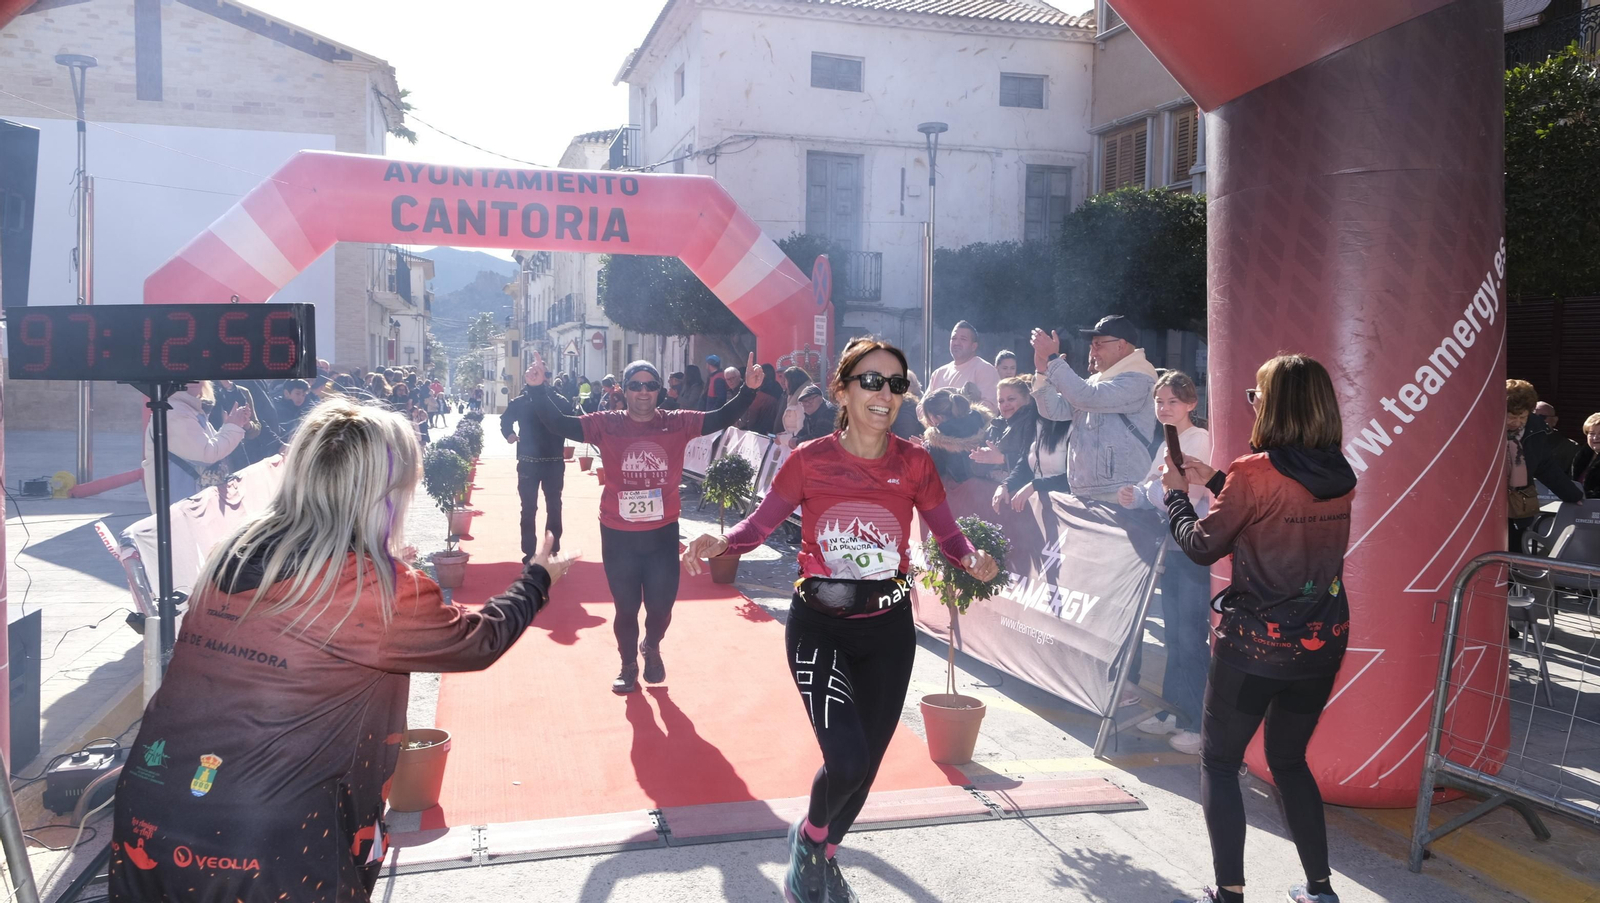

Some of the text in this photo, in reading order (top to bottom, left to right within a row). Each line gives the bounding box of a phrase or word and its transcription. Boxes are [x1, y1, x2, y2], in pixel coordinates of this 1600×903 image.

[383, 161, 640, 197] AYUNTAMIENTO
[391, 194, 631, 243] CANTORIA
[628, 500, 654, 514] 231
[829, 544, 839, 552] LA
[993, 572, 1101, 624] EAMERGY
[204, 638, 288, 669] ALMANZORA
[1253, 637, 1292, 648] COSENTINO
[195, 855, 260, 870] VEOLIA
